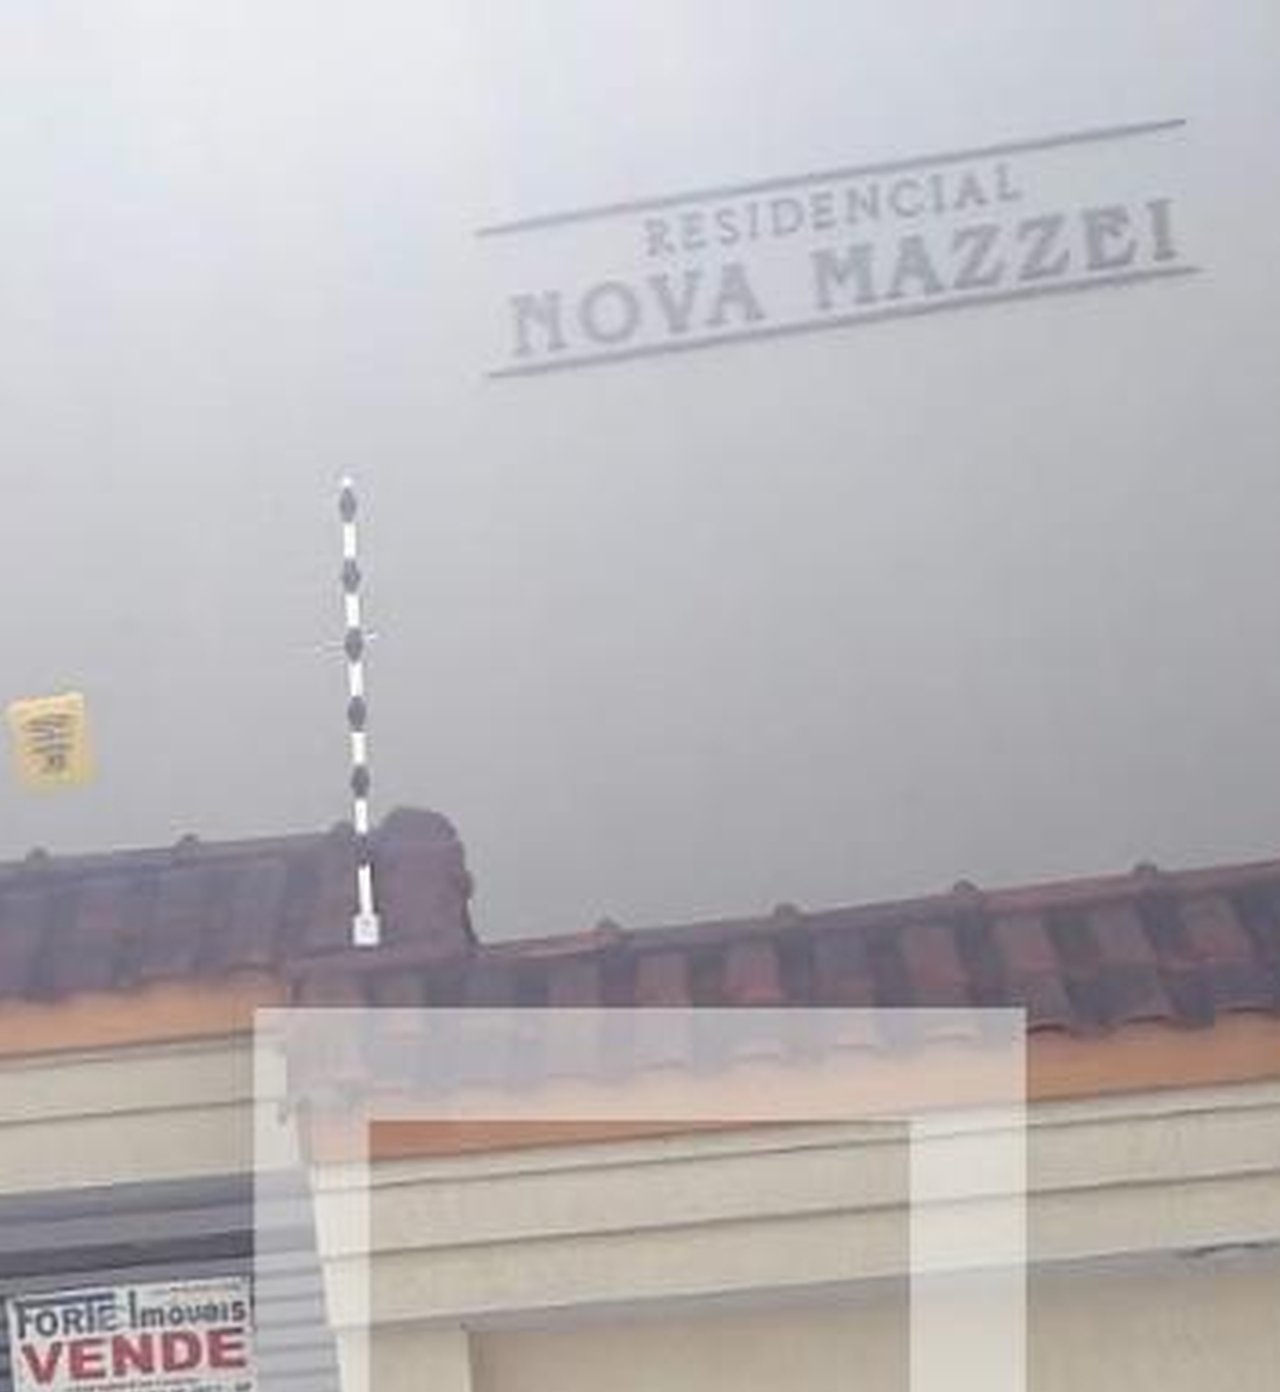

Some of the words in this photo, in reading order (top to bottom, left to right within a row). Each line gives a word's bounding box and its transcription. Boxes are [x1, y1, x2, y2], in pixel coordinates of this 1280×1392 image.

[643, 163, 1023, 256] RESIDENCIAL
[509, 262, 766, 355] NOVA
[809, 199, 1179, 309] MAZZEI
[20, 1327, 247, 1386] VENDE
